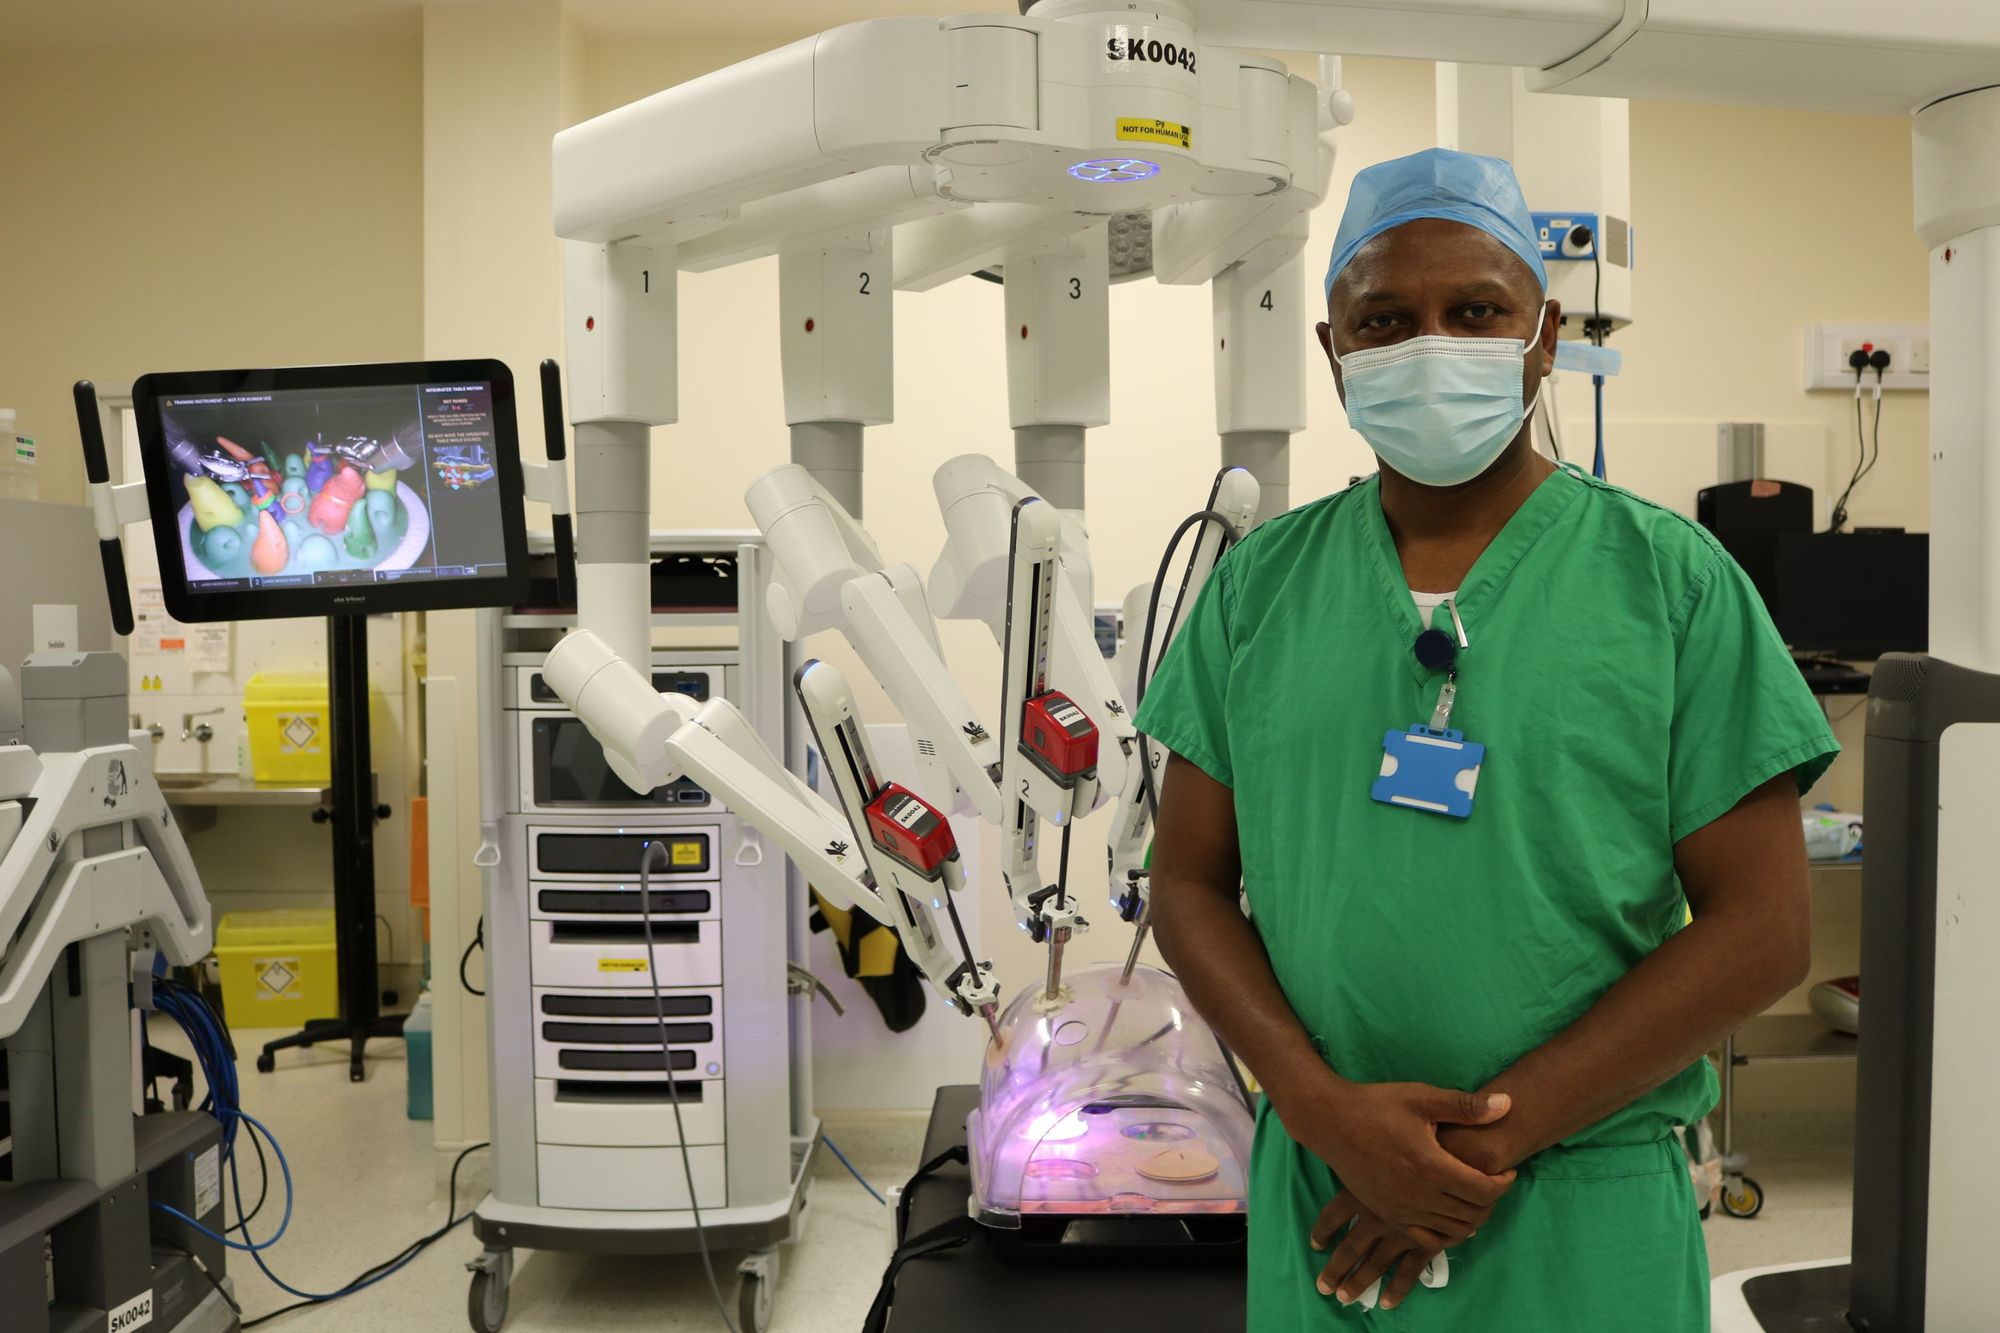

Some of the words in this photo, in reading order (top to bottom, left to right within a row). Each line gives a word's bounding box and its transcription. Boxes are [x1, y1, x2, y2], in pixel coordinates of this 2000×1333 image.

[1106, 38, 1197, 75] SK0042
[1122, 125, 1138, 133] NOT
[1140, 126, 1155, 134] FOR
[1155, 128, 1179, 139] HUMAN
[1179, 133, 1189, 141] USE
[642, 270, 649, 294] 1
[859, 271, 871, 296] 2
[1069, 277, 1081, 300] 3
[1260, 289, 1274, 312] 4
[1151, 751, 1161, 770] 3
[1021, 779, 1030, 798] 2
[900, 804, 921, 824] SK0042
[111, 1299, 150, 1333] SK0042
